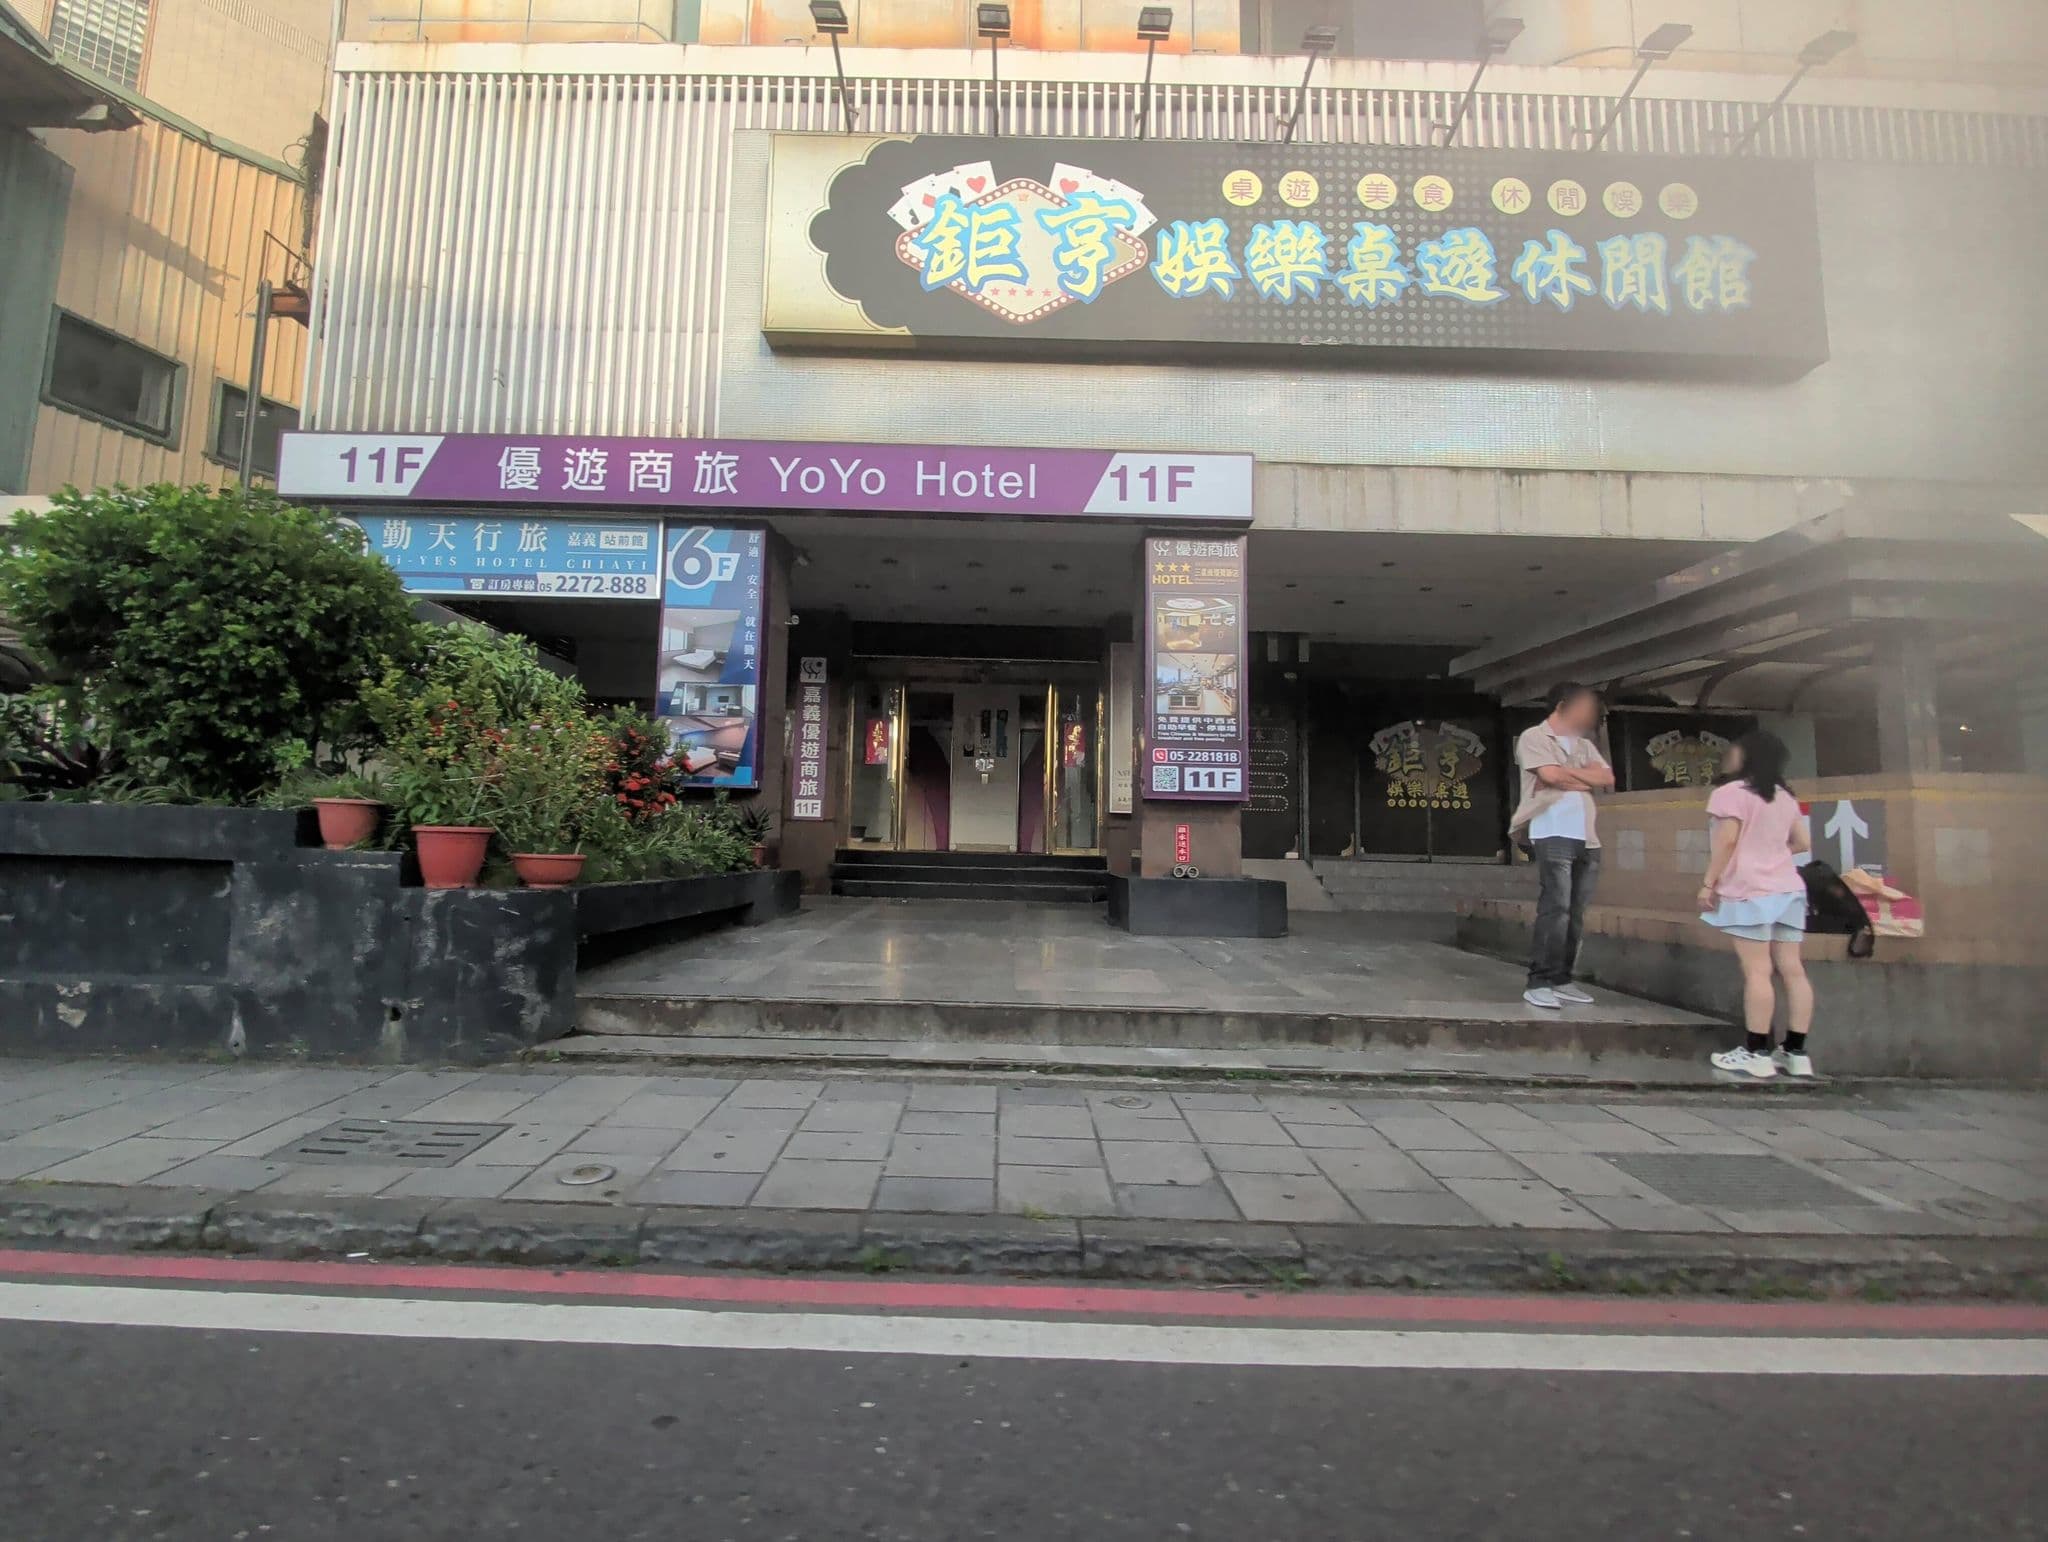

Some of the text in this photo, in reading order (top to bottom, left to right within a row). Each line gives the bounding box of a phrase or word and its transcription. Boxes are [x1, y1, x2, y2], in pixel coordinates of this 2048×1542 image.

[1227, 175, 1314, 204] 桌遊
[1362, 180, 1448, 208] 美食
[339, 446, 425, 484] 11F
[497, 446, 1037, 499] 優遊商旅 YoYo Hotel
[1109, 464, 1196, 503] 11F
[382, 519, 645, 553] 勤天行旅 嘉義 站前館
[1175, 540, 1240, 558] 優遊商旅
[476, 556, 548, 569] HOTEL
[566, 558, 648, 571] CHIAYI
[487, 574, 648, 595] 訂房專線 05 2272-888
[1152, 574, 1194, 585] HOTEL
[799, 686, 822, 797] 嘉義優遊商旅
[1169, 750, 1238, 763] 05-2281818
[1188, 771, 1237, 788] 11F
[796, 801, 819, 815] 11F
